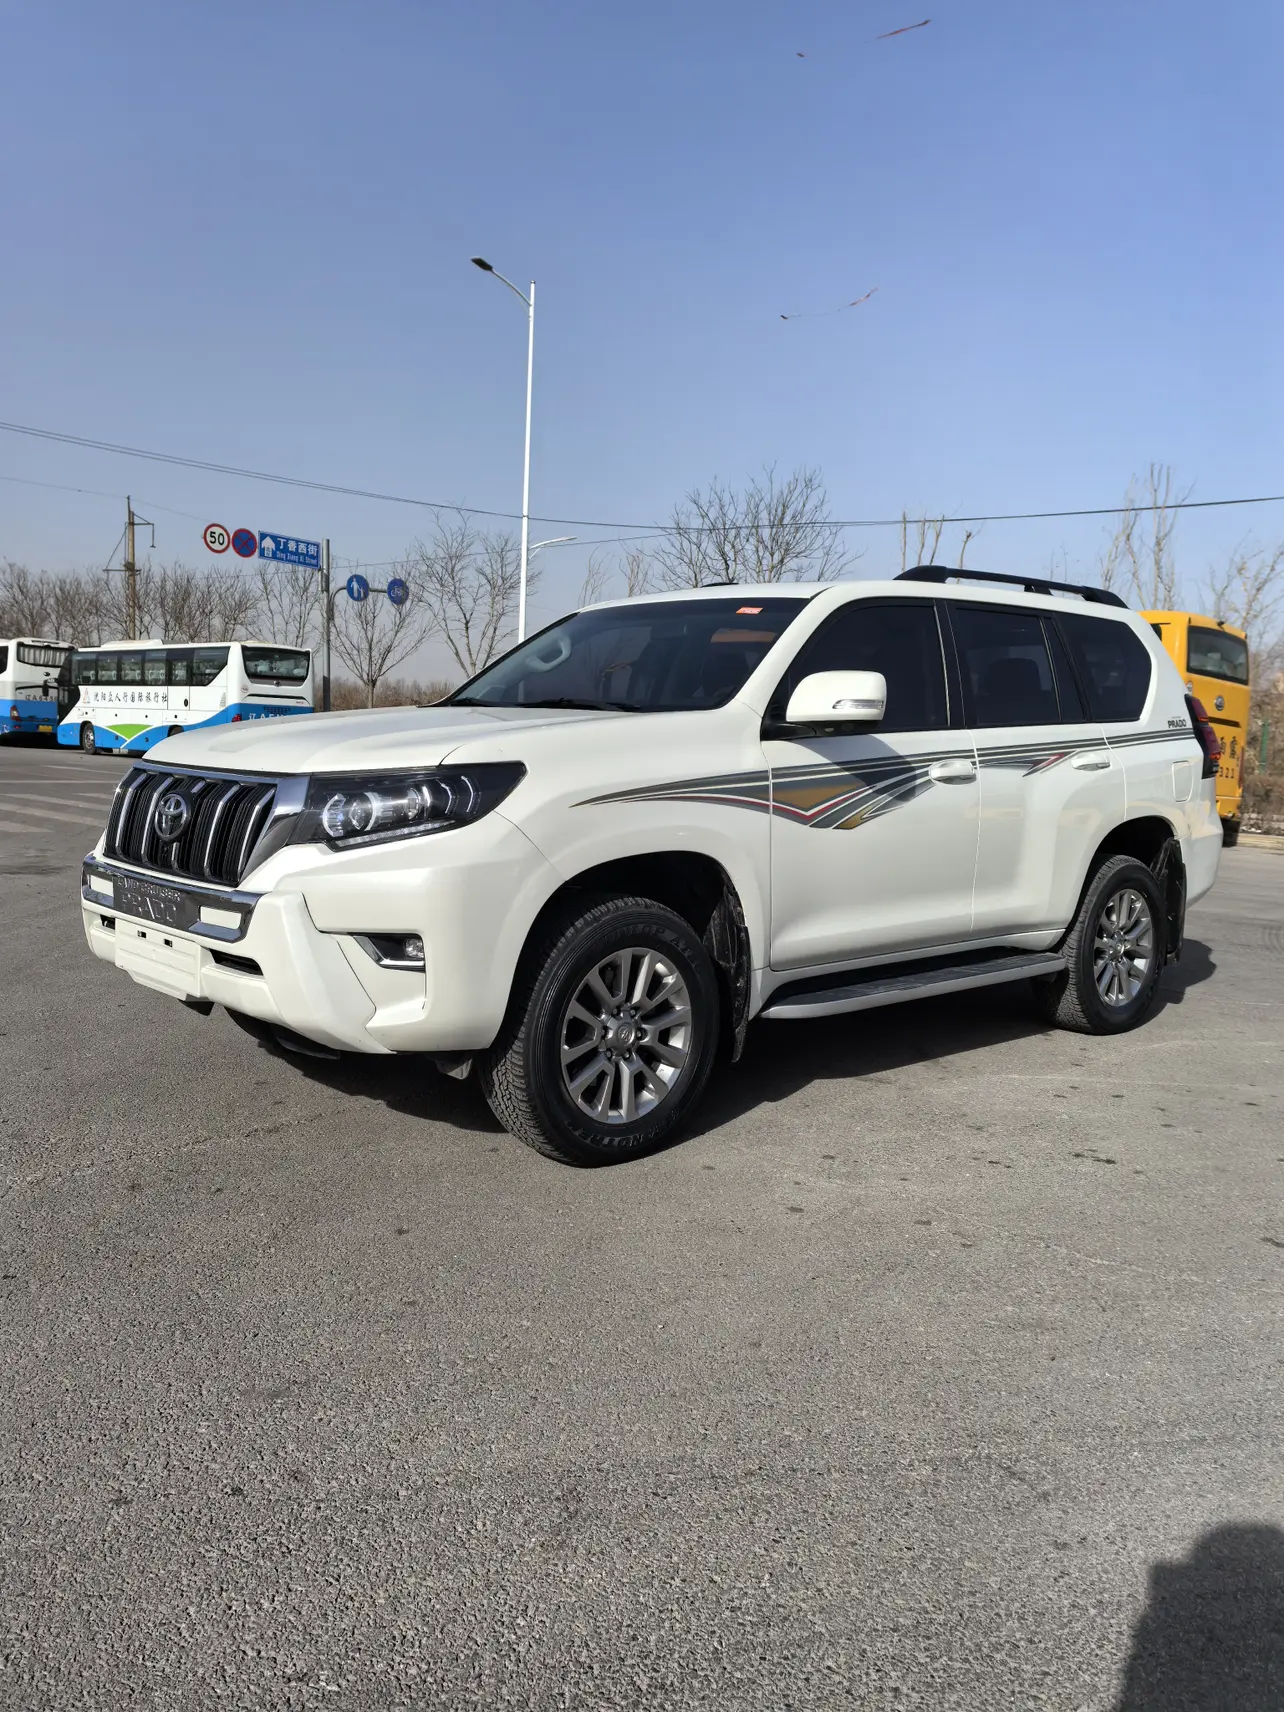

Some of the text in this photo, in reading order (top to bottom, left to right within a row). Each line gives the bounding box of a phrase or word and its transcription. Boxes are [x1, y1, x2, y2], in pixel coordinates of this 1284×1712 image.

[209, 530, 225, 546] 50
[276, 537, 318, 556] 丁香西街
[305, 556, 318, 565] Street
[1167, 719, 1187, 728] PRADO
